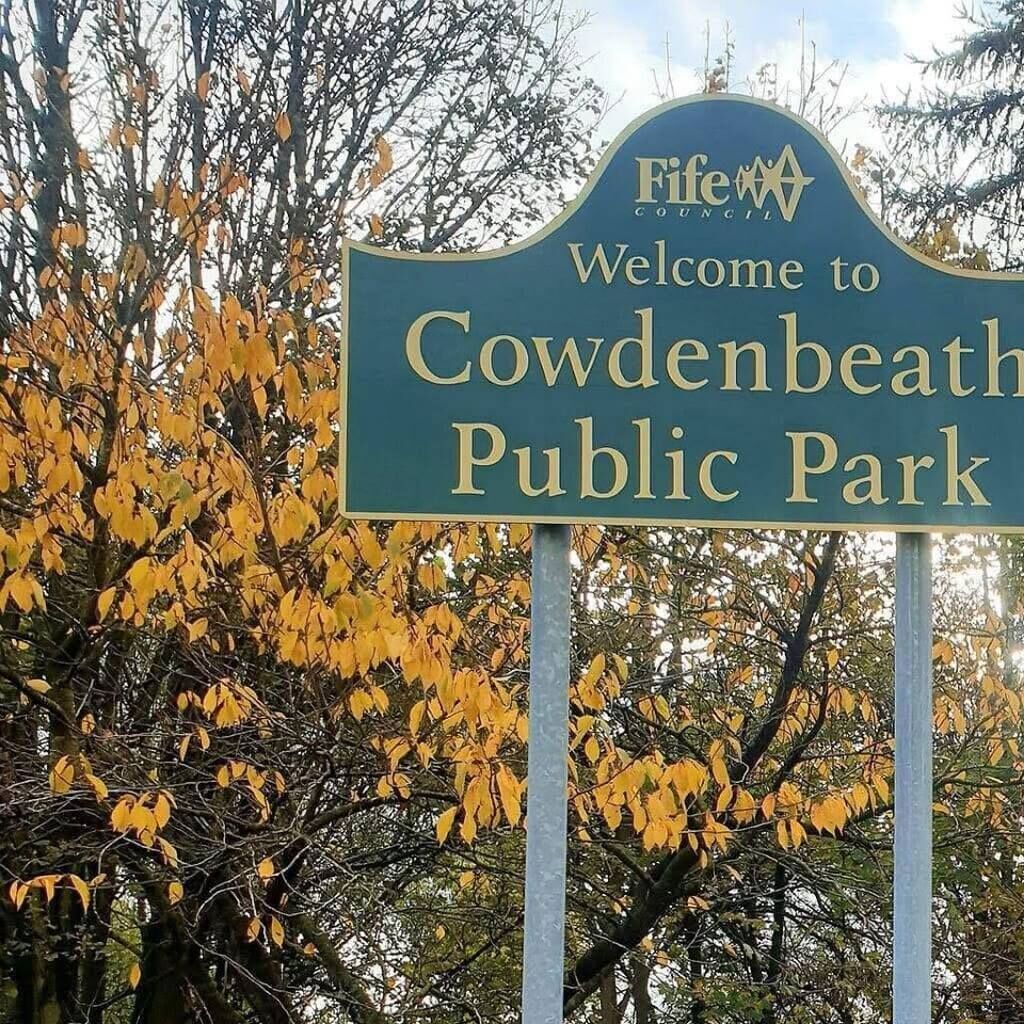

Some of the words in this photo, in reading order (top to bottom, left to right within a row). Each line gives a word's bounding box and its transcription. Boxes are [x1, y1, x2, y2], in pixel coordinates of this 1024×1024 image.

[634, 153, 730, 206] Fife
[634, 207, 773, 221] COUNCIL
[567, 239, 804, 290] Welcome
[830, 256, 880, 292] to
[451, 416, 739, 502] Public
[785, 424, 992, 507] Park
